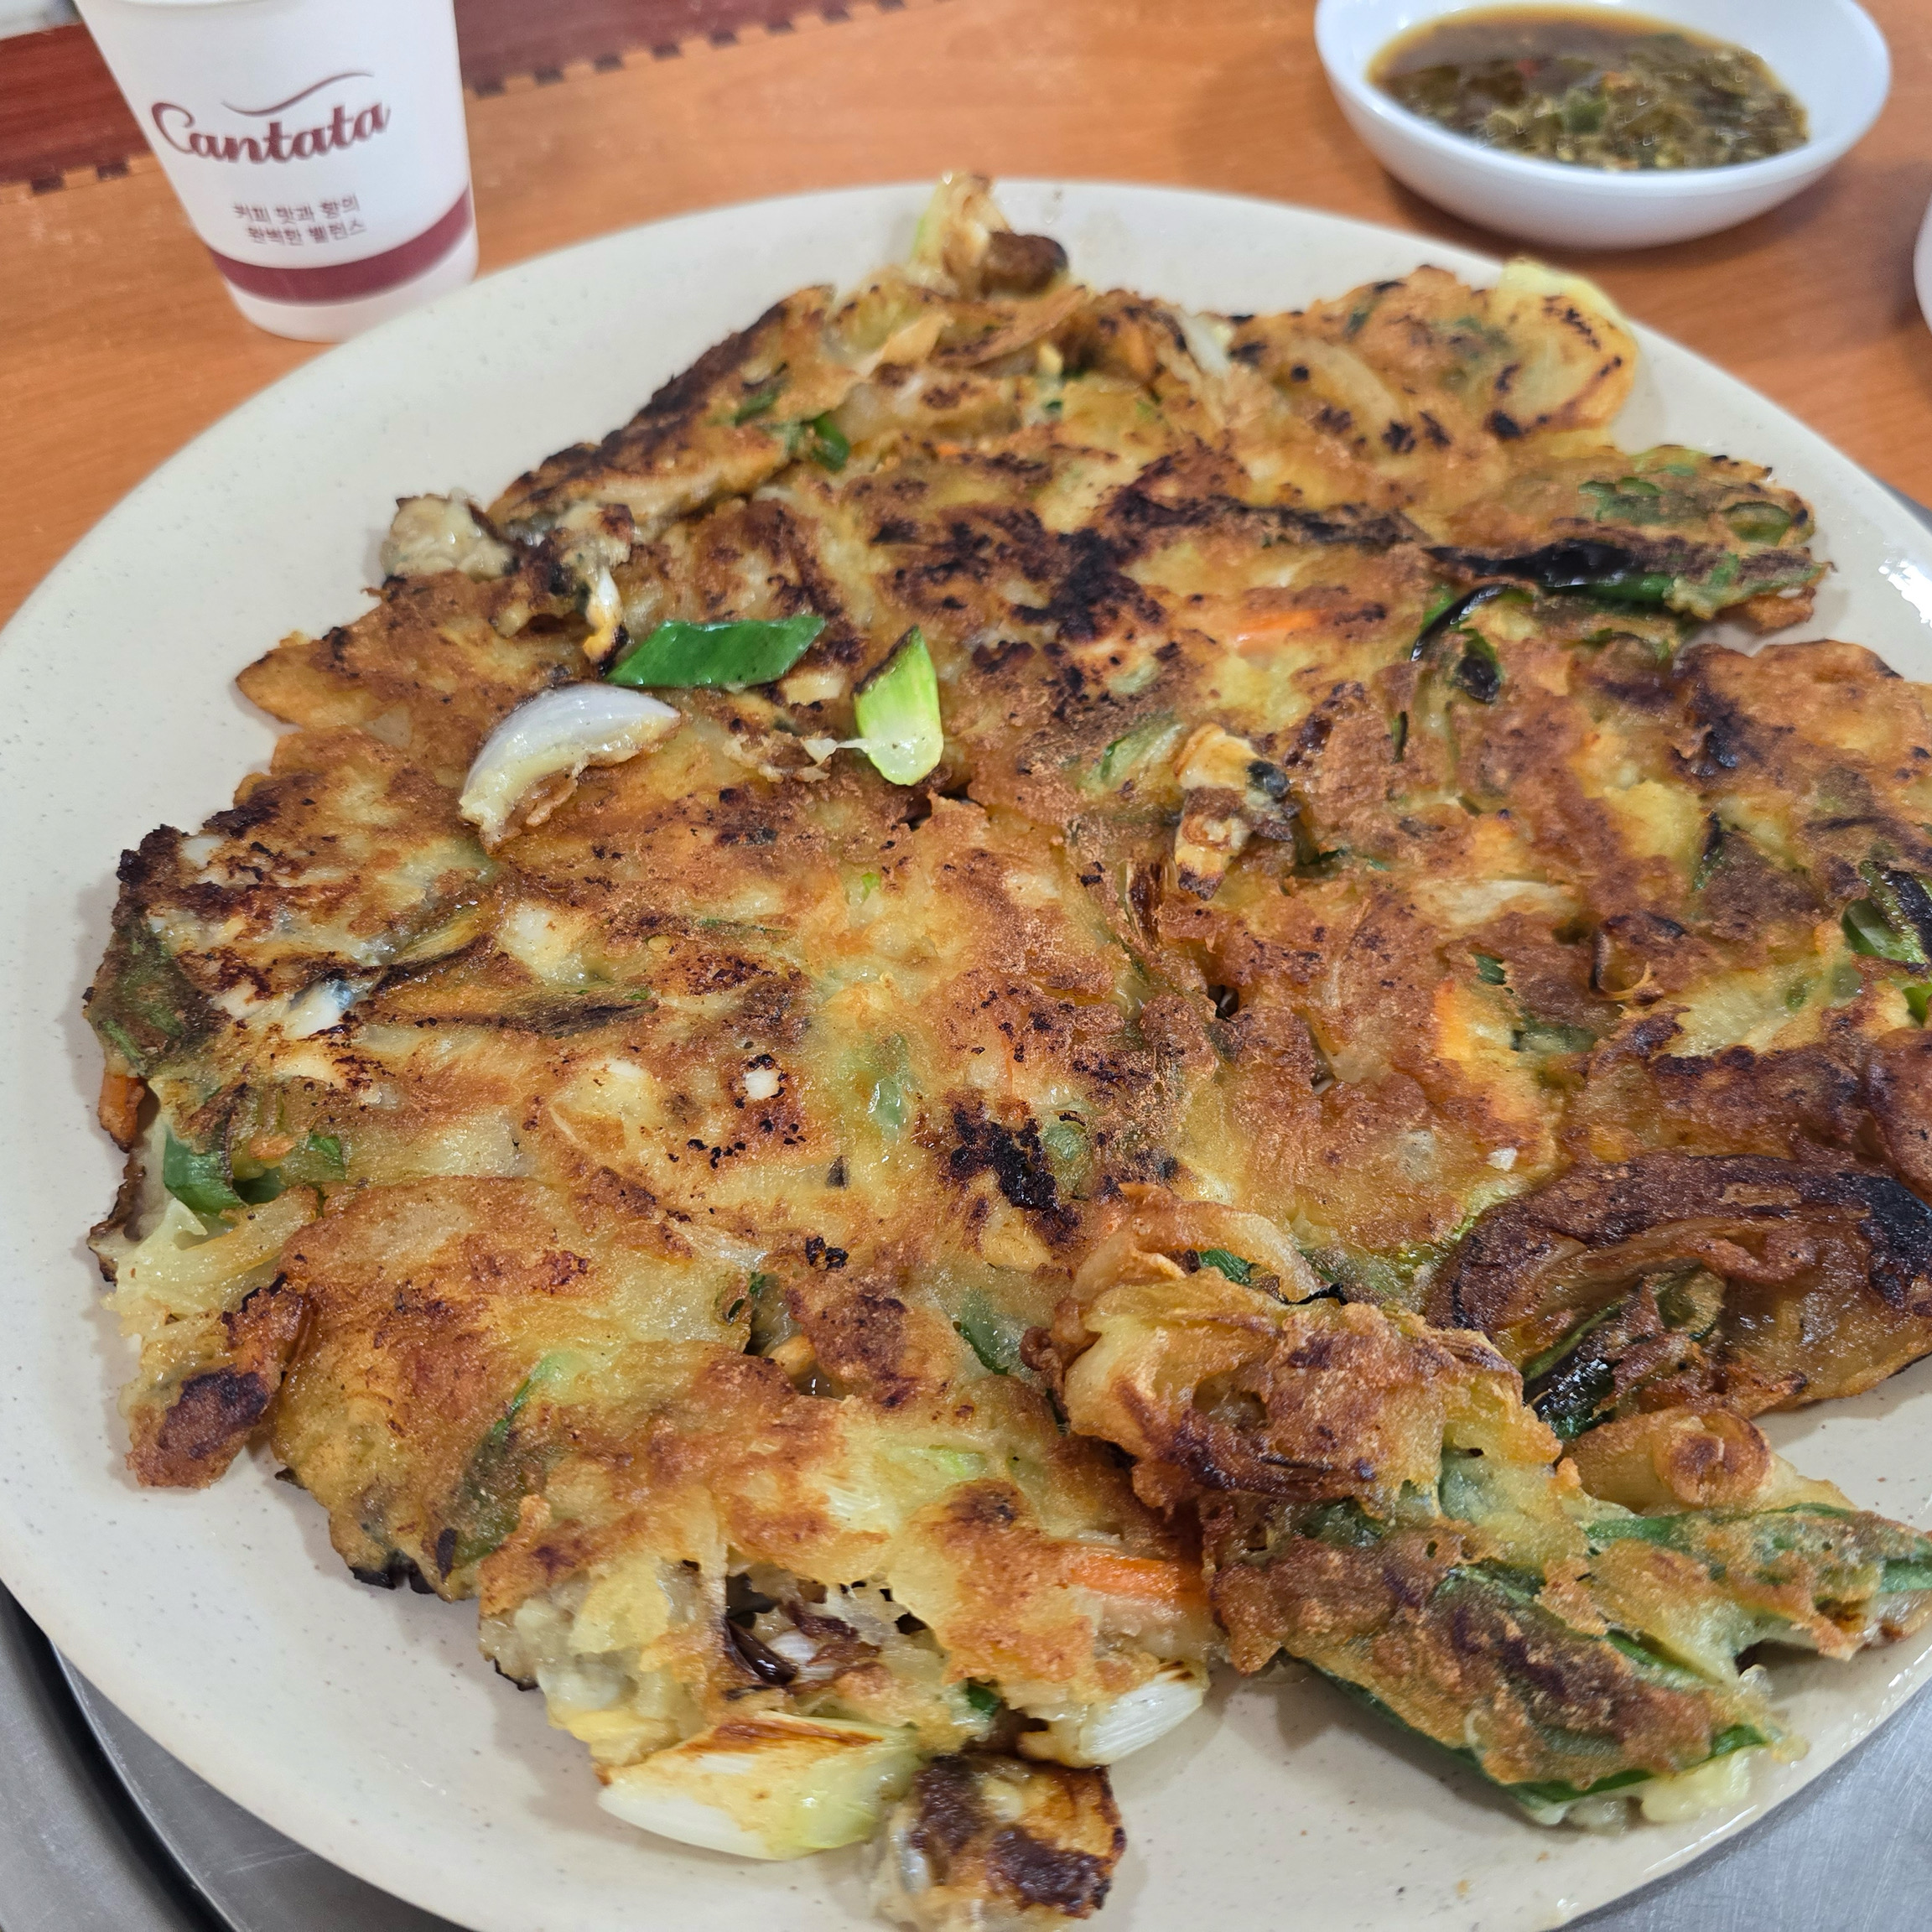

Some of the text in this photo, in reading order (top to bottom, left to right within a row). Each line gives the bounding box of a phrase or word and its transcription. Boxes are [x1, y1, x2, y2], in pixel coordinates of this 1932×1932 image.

[151, 101, 391, 164] Cantata
[234, 194, 360, 223] 커피 맛과 향의
[247, 227, 304, 246] 완벽한
